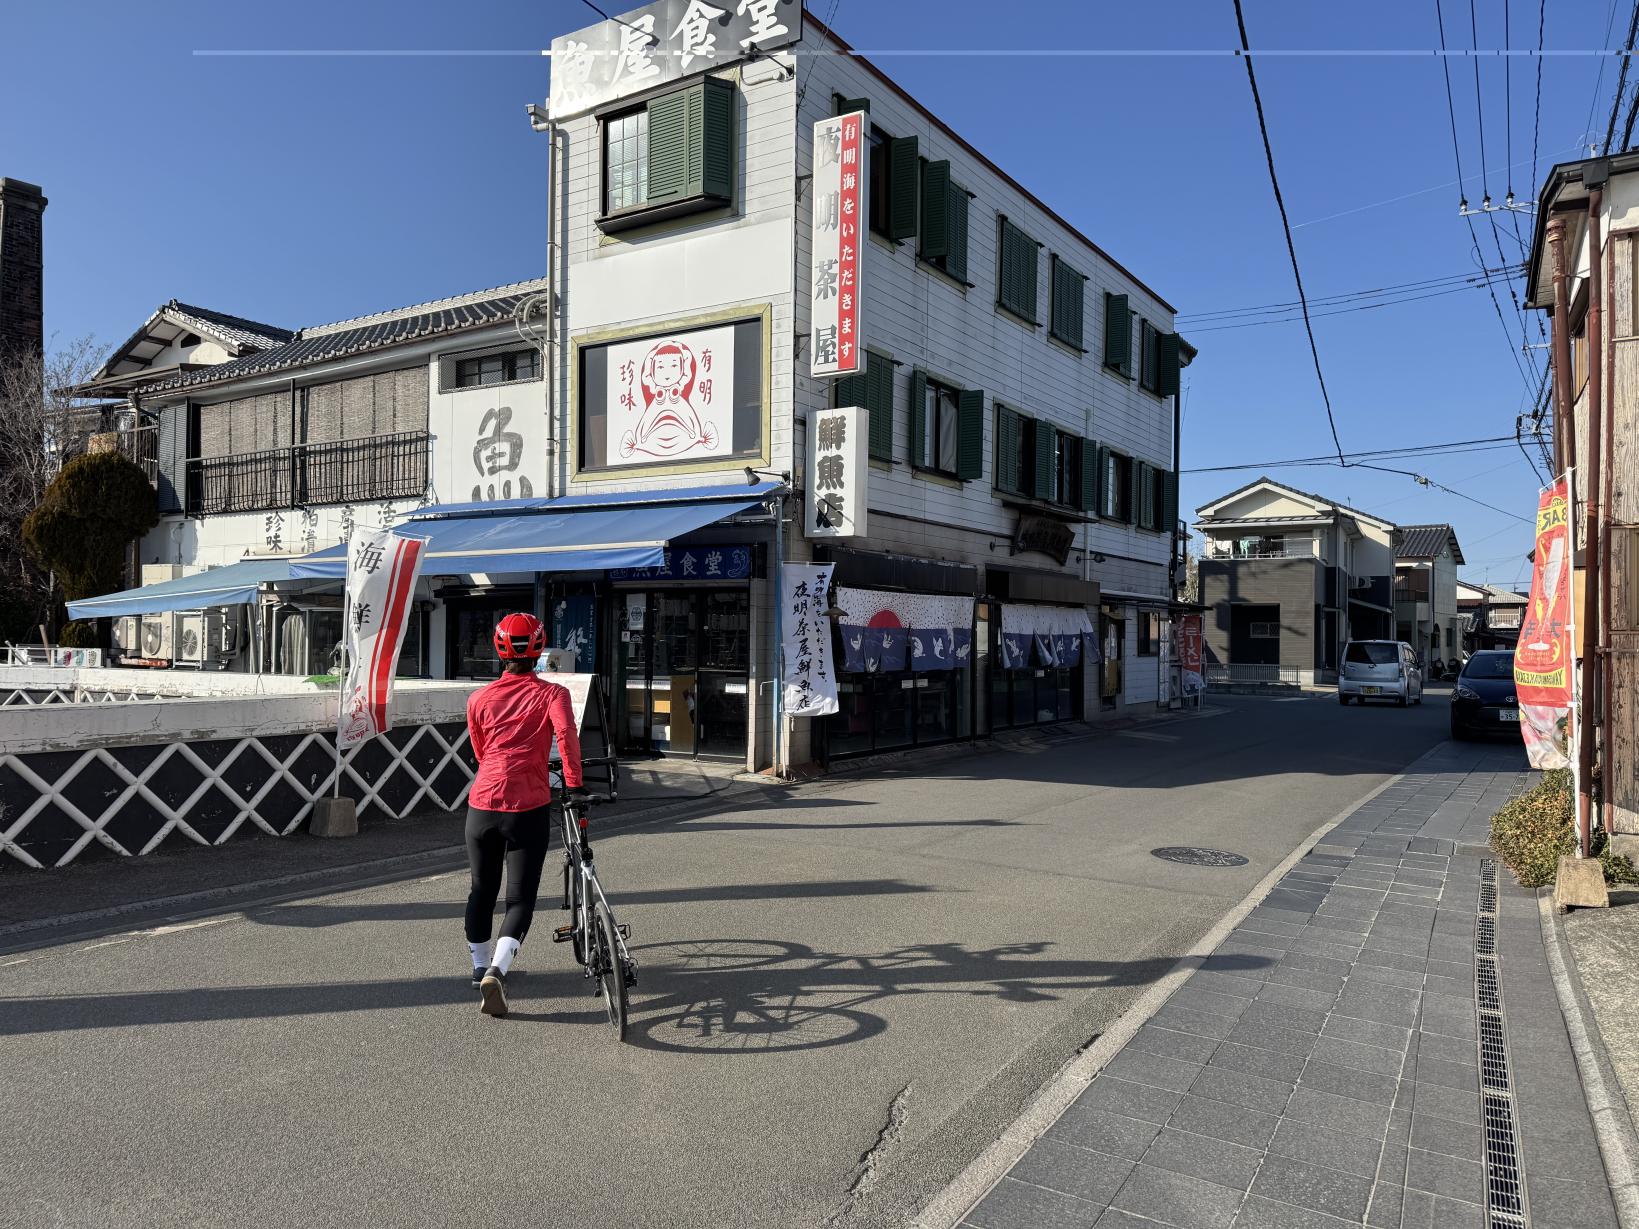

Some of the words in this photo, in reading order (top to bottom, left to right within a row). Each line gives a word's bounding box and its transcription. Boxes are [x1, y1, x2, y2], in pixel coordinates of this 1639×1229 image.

[841, 123, 856, 358] 有明海をいただきます
[620, 360, 636, 411] 珍味
[700, 348, 713, 405] 有明
[265, 510, 285, 553] 珍味
[378, 501, 397, 529] 活
[353, 541, 386, 634] 海鮮
